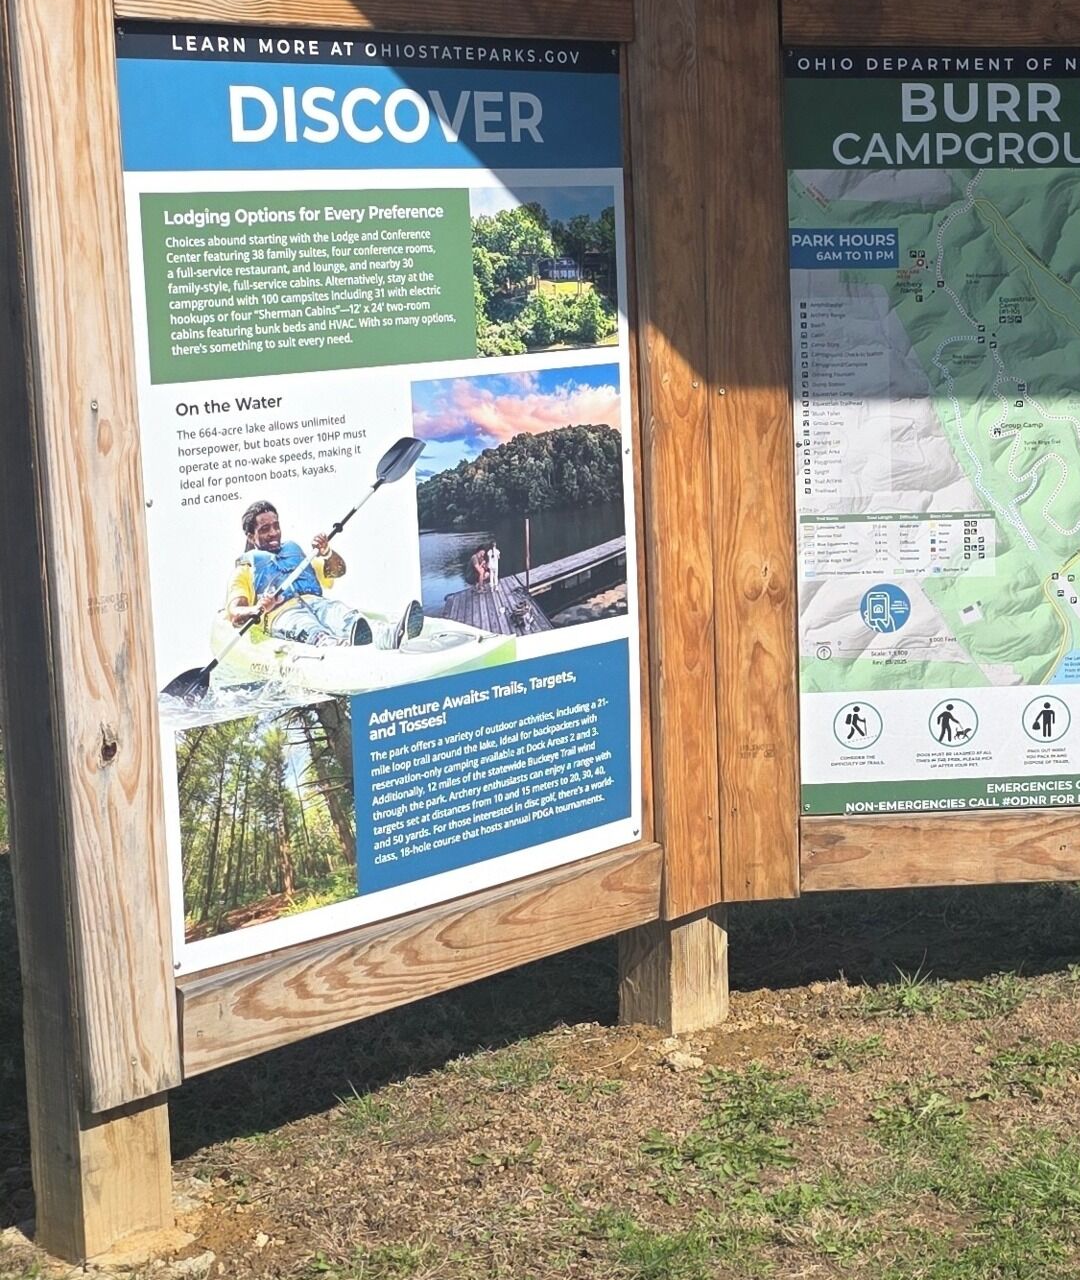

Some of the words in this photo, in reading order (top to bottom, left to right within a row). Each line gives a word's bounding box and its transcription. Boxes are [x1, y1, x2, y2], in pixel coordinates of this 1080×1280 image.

[172, 34, 245, 52] LEARN
[258, 38, 319, 55] MORE
[330, 41, 354, 56] AT
[364, 42, 579, 64] OHIOSTATEPARKS.GOV
[797, 57, 853, 70] OHIO
[866, 57, 1014, 71] DEPARTMENT
[1026, 57, 1052, 70] OF
[901, 82, 1061, 123] BURR
[228, 85, 544, 146] DISCOVER
[163, 207, 231, 228] Lodging
[234, 206, 296, 226] Options
[298, 206, 320, 221] for
[323, 206, 365, 223] Every
[368, 204, 444, 219] Preference
[165, 236, 206, 248] Choices
[207, 234, 246, 246] abound
[248, 233, 288, 247] starting
[289, 232, 311, 243] with
[312, 231, 329, 243] the
[330, 230, 359, 244] Lodge
[360, 229, 378, 241] and
[380, 228, 431, 240] Conference
[791, 234, 835, 247] PARK
[839, 233, 895, 246] HOURS
[816, 250, 842, 260] 6AM
[844, 250, 861, 260] TO
[863, 250, 872, 260] 11
[875, 250, 894, 260] PM
[175, 402, 199, 416] On
[203, 399, 231, 414] the
[234, 396, 282, 411] Water
[176, 429, 196, 440] The
[198, 426, 243, 438] 664-acre
[245, 422, 266, 433] lake
[268, 420, 299, 431] allows
[300, 415, 345, 428] unlimited
[177, 443, 240, 456] horsepower,
[243, 439, 261, 450] but
[263, 437, 290, 448] boats
[292, 435, 314, 445] over
[316, 430, 340, 442] 10HP
[342, 429, 366, 439] must
[178, 461, 219, 475] operate
[221, 459, 232, 469] at
[234, 453, 277, 467] no-wake
[278, 449, 315, 464] speeds,
[317, 446, 352, 458] making
[354, 444, 361, 454] it
[179, 477, 204, 490] ideal
[207, 476, 222, 486] for
[225, 472, 267, 487] pontoon
[269, 468, 299, 479] boats,
[301, 463, 336, 477] kayaks,
[180, 494, 200, 506] and
[203, 491, 242, 503] canoes.
[368, 701, 440, 726] Adventure
[442, 689, 490, 709] Awaits:
[490, 680, 527, 698] Trails,
[528, 671, 576, 690] Targets,
[369, 722, 396, 740] and
[398, 711, 446, 733] Tosses!
[986, 780, 1073, 793] EMERGENCIES
[845, 798, 966, 812] NON-EMERGENCIES
[968, 796, 999, 808] CALL
[1002, 795, 1046, 807] #ODNR
[1050, 792, 1075, 805] FOR
